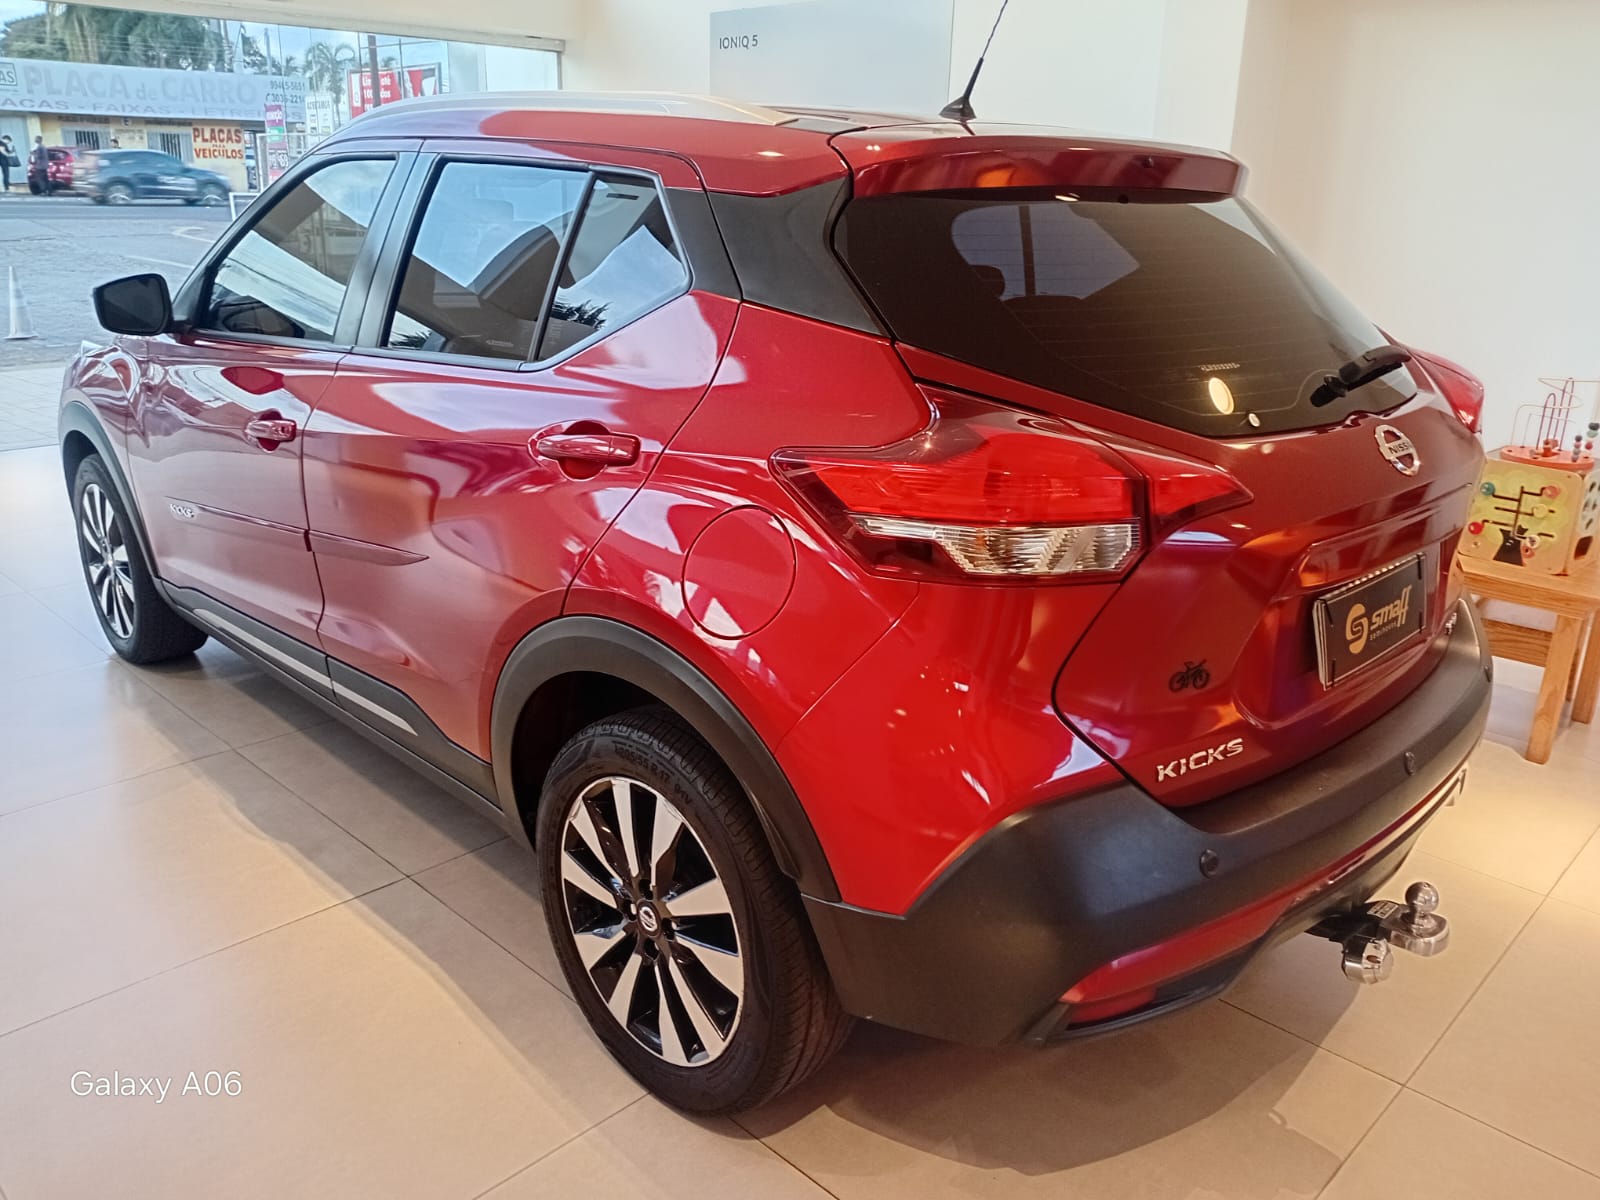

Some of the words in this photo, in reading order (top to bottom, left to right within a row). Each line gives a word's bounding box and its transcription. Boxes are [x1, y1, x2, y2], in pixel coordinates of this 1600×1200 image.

[719, 35, 749, 50] IONIQ
[751, 34, 758, 47] 5
[23, 65, 130, 99] PLACA
[136, 81, 157, 101] de
[161, 75, 258, 105] CARRO
[92, 103, 171, 115] FAIXAS
[192, 127, 242, 144] PLACAS
[194, 147, 244, 160] VEICULOS
[1156, 737, 1245, 783] KICKS
